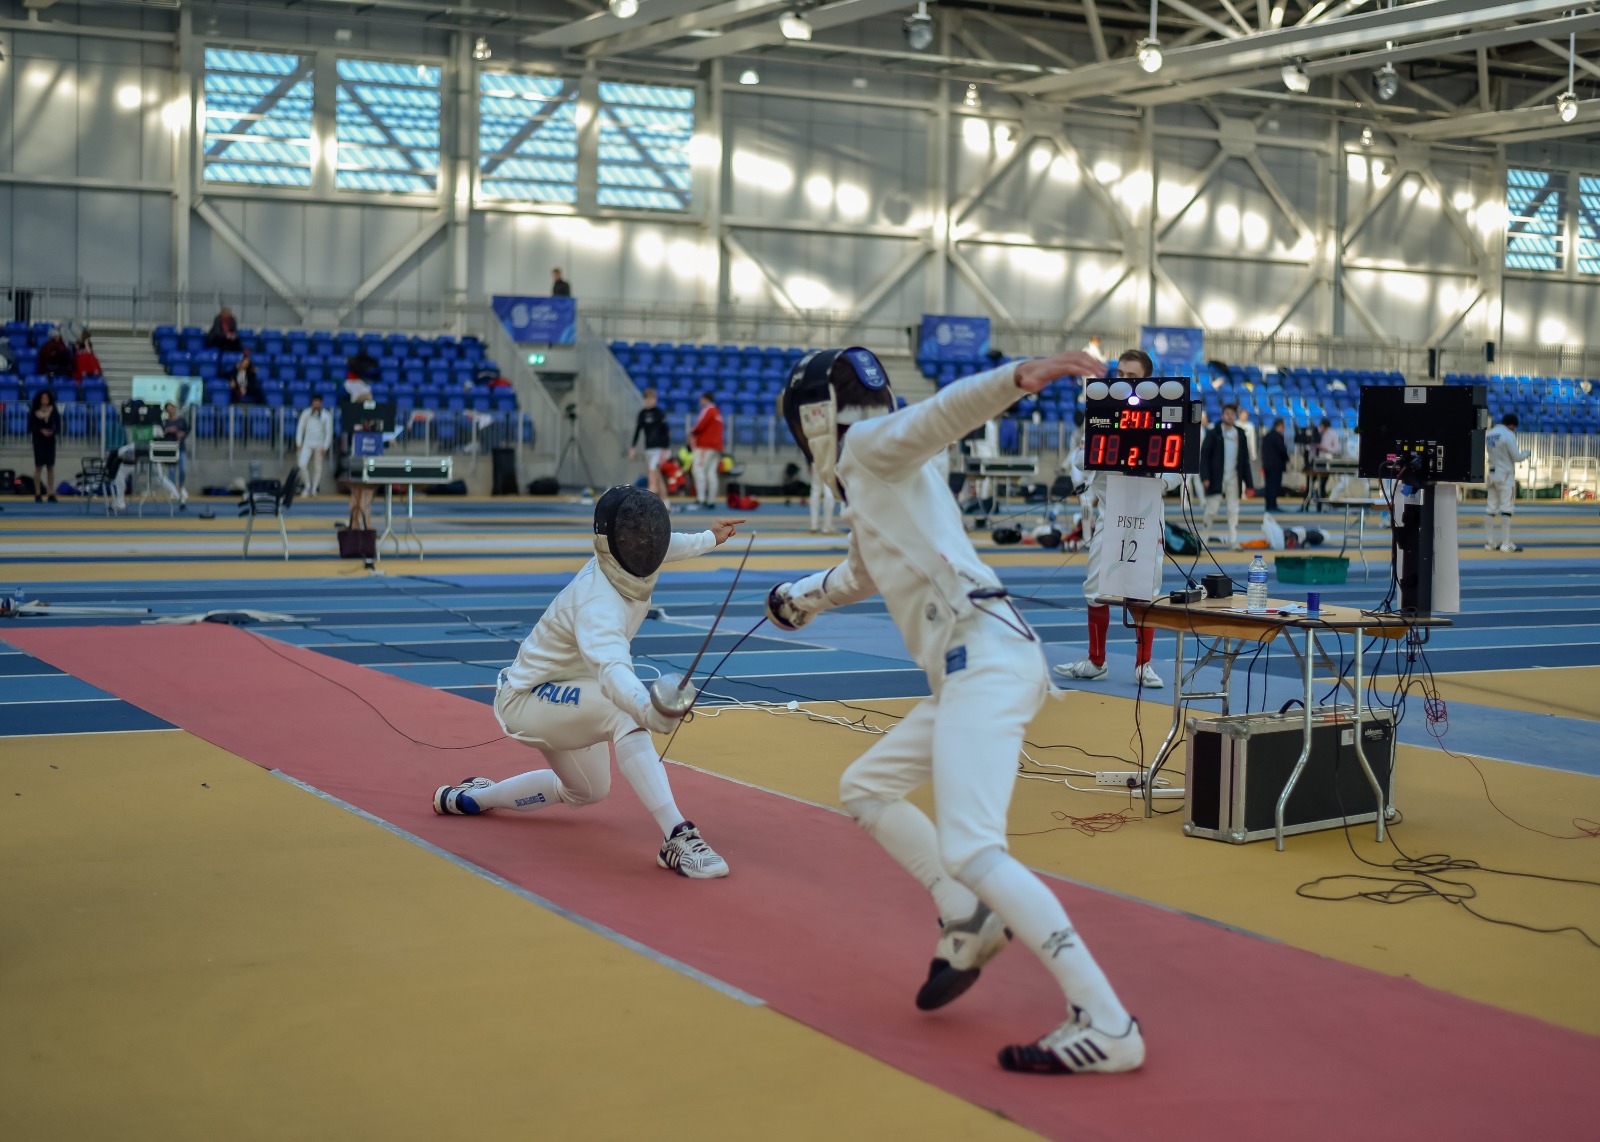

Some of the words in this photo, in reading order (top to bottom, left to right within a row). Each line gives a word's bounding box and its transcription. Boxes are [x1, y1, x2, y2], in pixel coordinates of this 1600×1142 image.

[1127, 447, 1138, 466] 2
[1163, 434, 1182, 468] 0
[1116, 515, 1146, 529] PISTE
[1118, 539, 1138, 564] 12
